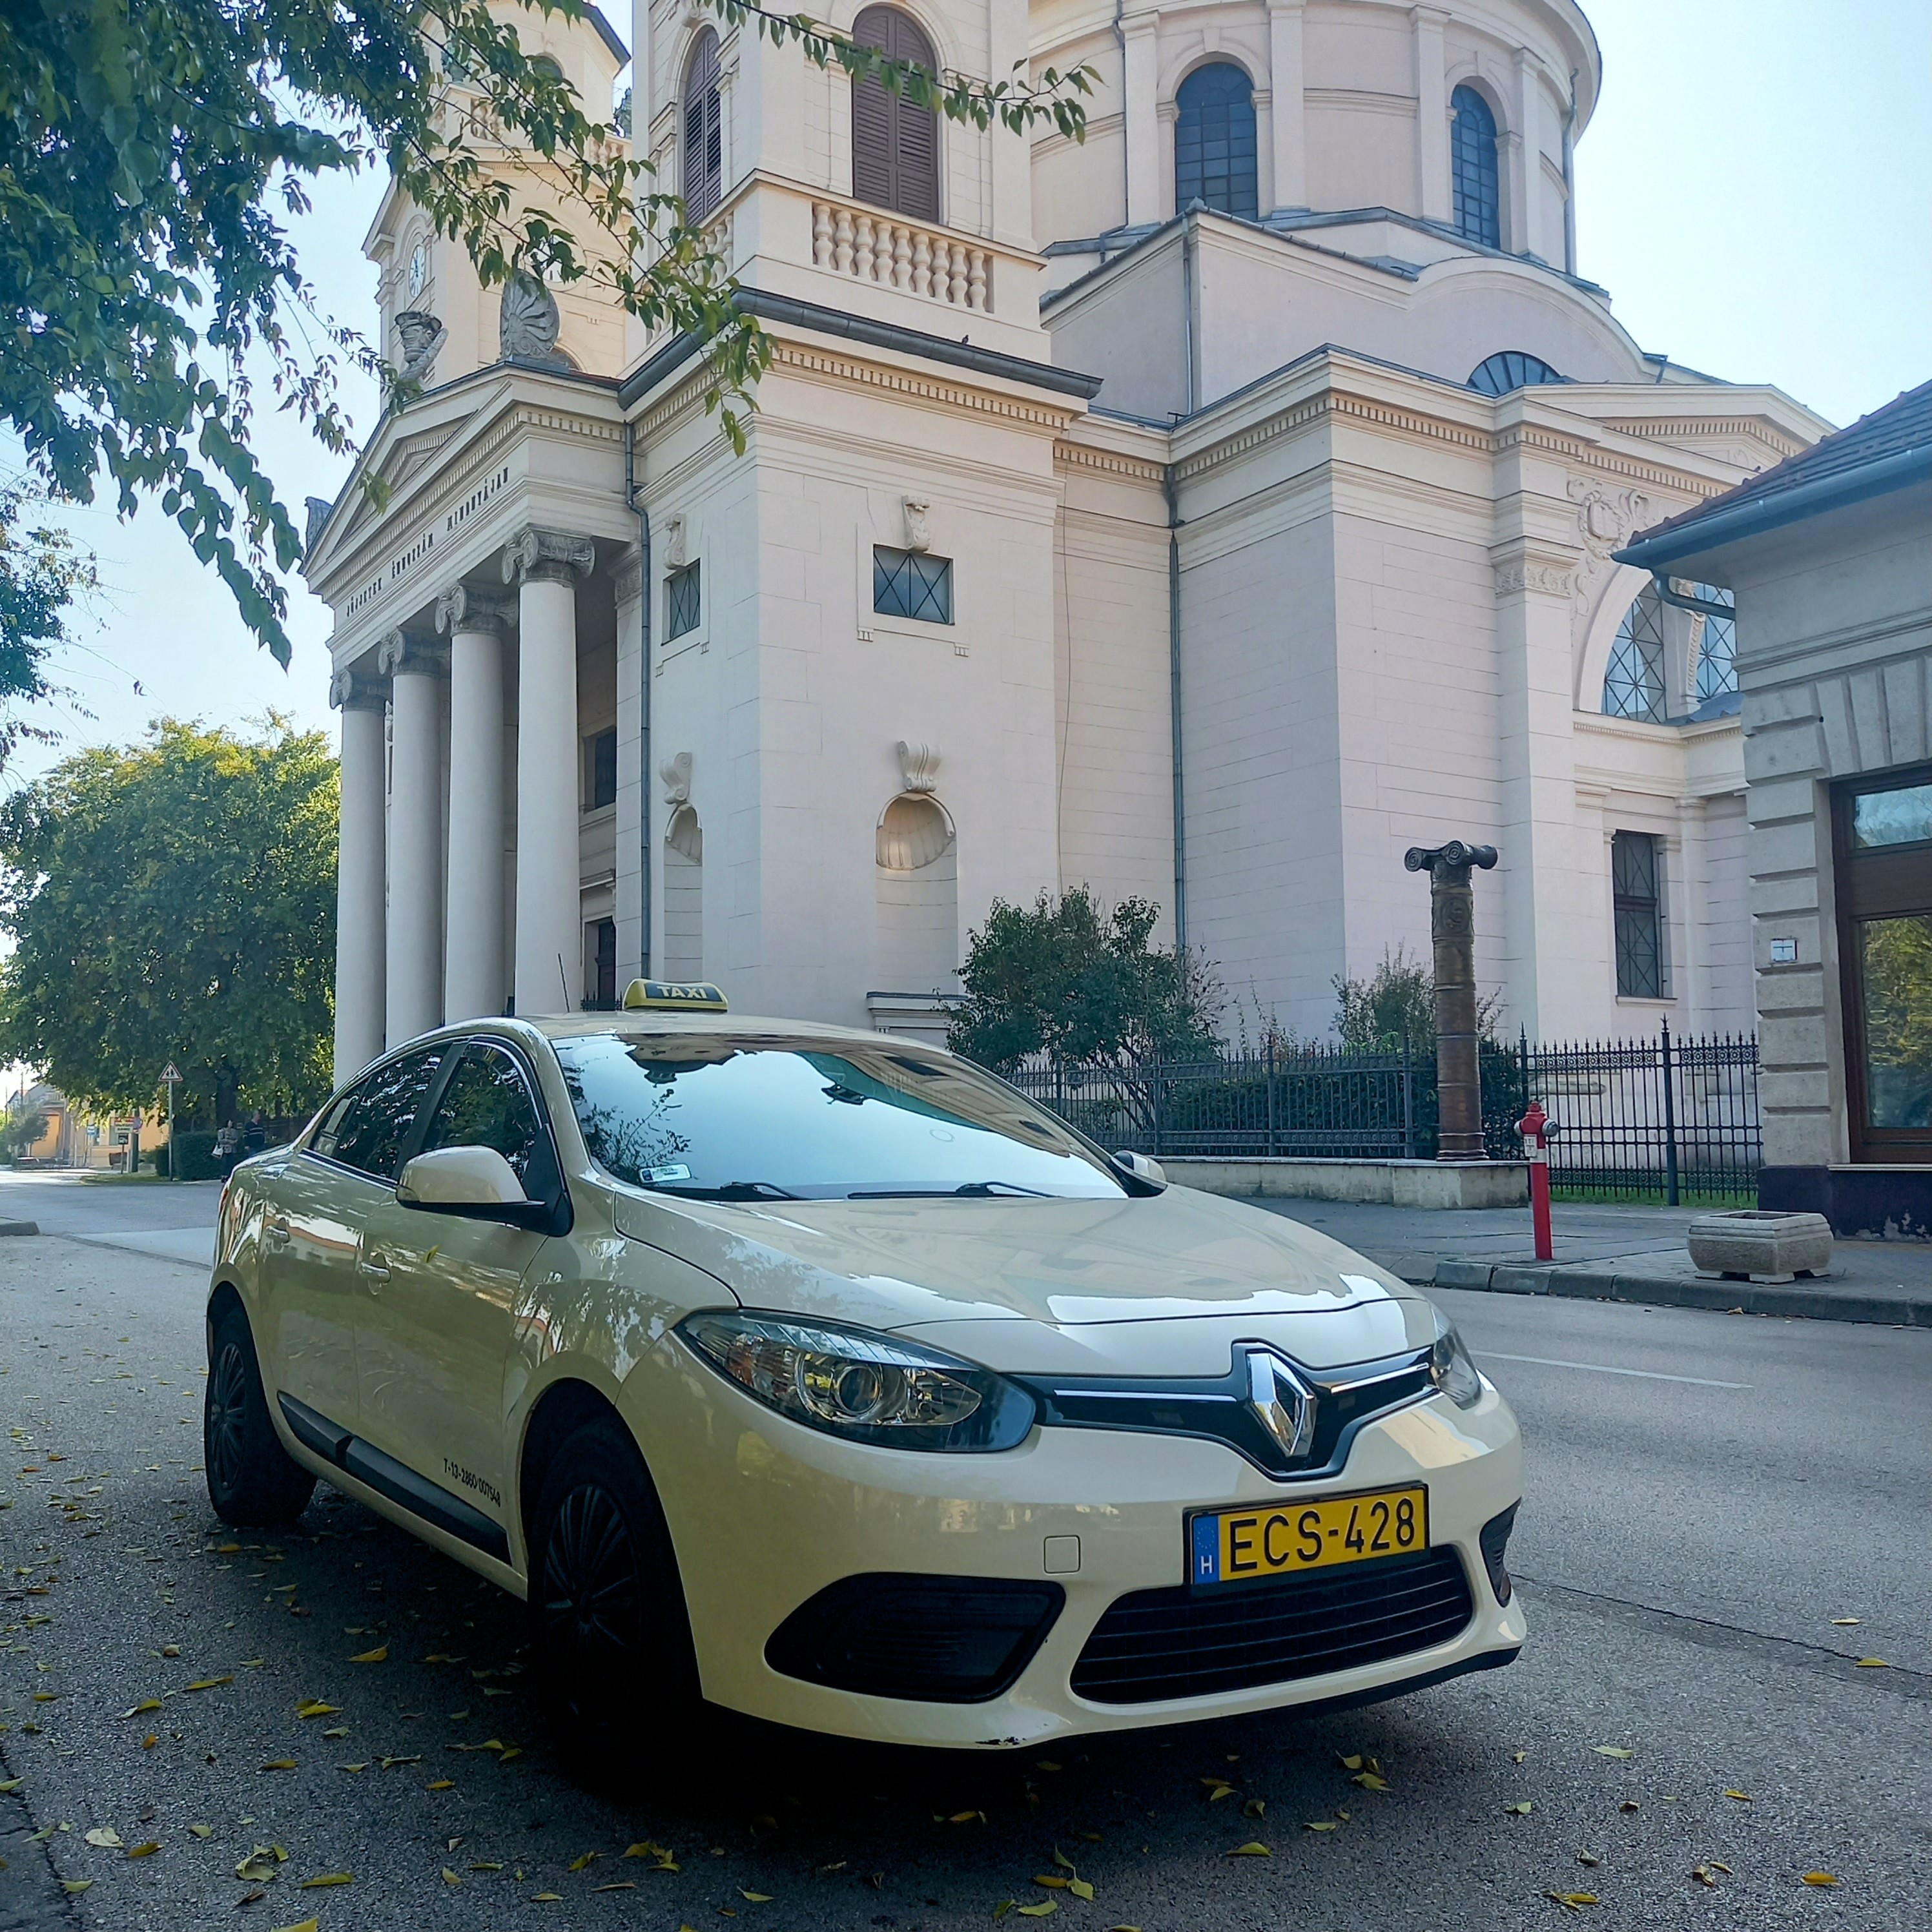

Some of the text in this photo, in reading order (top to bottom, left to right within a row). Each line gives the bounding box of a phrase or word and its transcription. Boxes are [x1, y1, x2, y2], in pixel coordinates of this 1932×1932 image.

[657, 986, 708, 998] TAXI
[1201, 1497, 1415, 1574] H ECS-428
